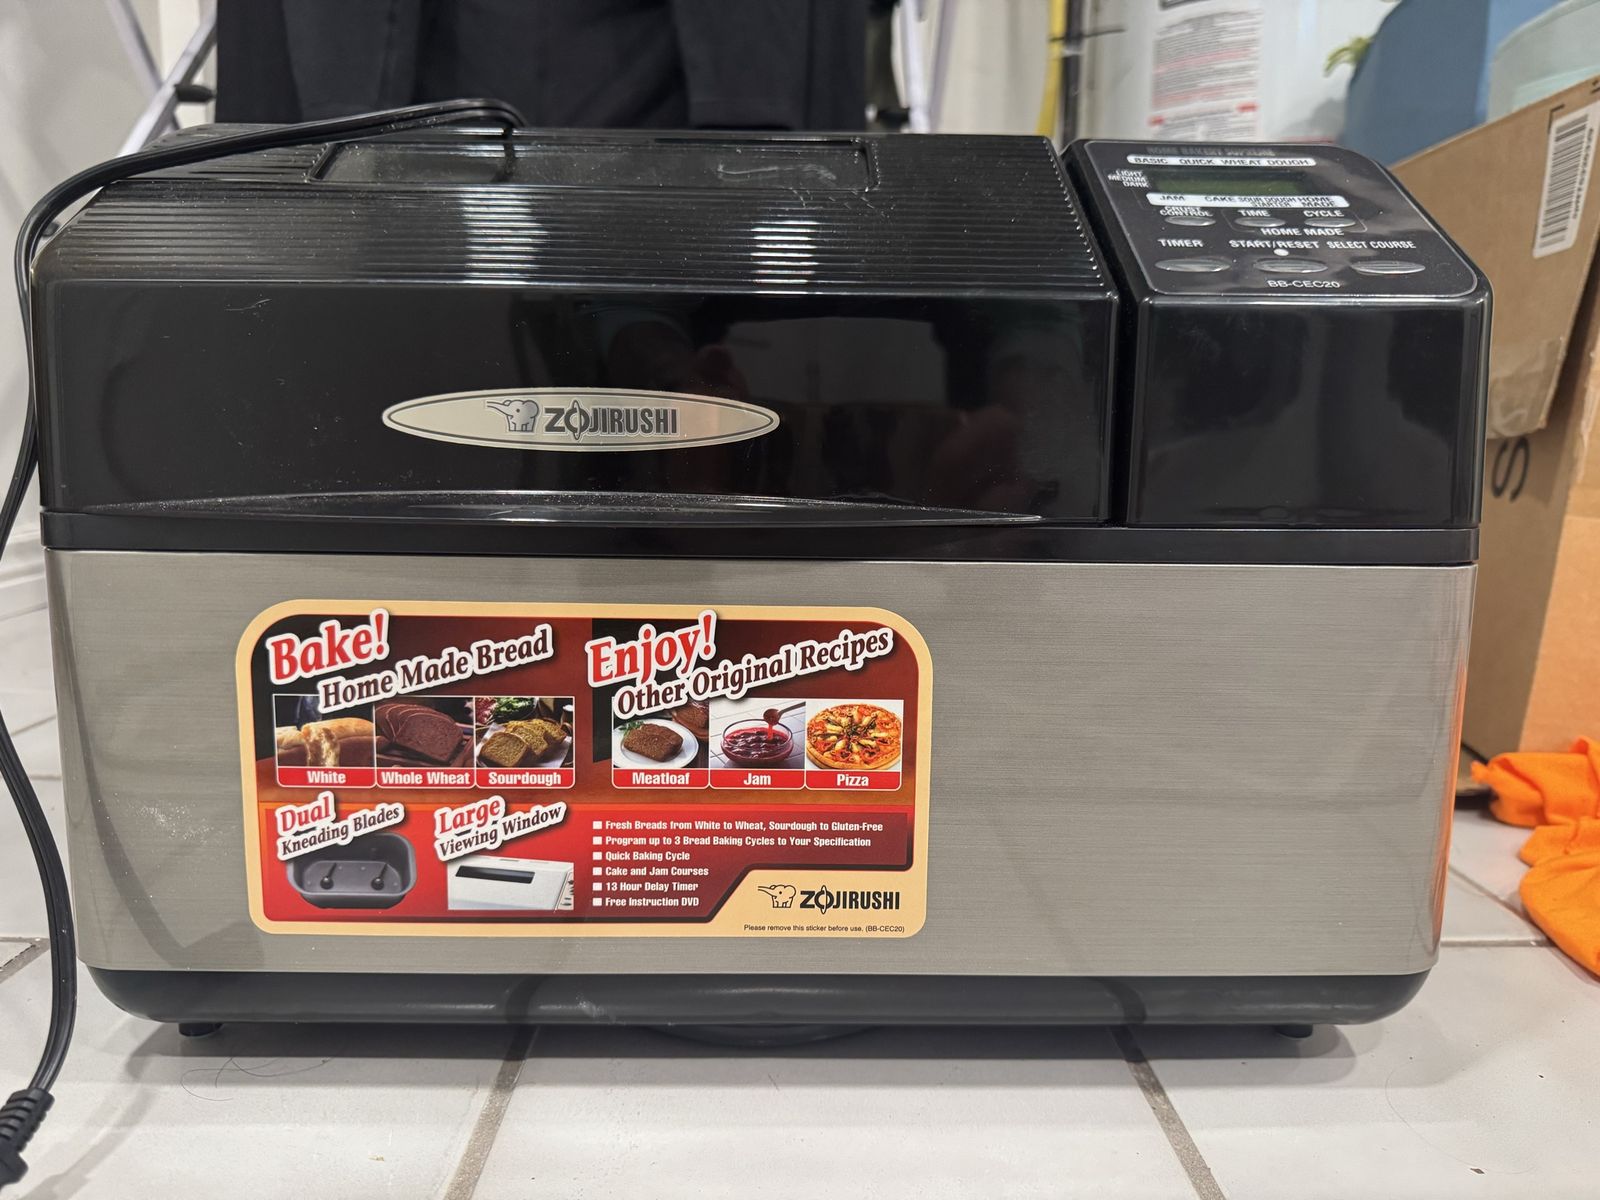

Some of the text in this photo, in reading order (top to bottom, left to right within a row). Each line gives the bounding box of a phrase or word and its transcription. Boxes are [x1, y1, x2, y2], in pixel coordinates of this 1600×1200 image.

[1160, 209, 1213, 217] CONTROL
[1304, 228, 1344, 236] MADE
[1158, 239, 1203, 247] TIMER
[1229, 240, 1319, 249] START/RESET
[1327, 241, 1416, 249] SELECT COURSE
[1267, 280, 1341, 288] BB-CEC20
[545, 400, 678, 441] ZOJIRUSHI
[270, 612, 386, 681] Bake!
[589, 614, 713, 682] Enjoy!
[321, 629, 549, 709] Home Made Bread
[617, 629, 890, 715] Other Original Recipes
[306, 770, 346, 784] White
[381, 771, 470, 785] Whole Wheat
[488, 771, 562, 787] Sourdough
[632, 772, 690, 785] Meatloaf
[743, 773, 772, 786] Jam
[836, 773, 869, 787] Pizza
[279, 796, 331, 832] Dual
[437, 799, 501, 835] Large
[282, 805, 400, 856] Kneading Blades
[439, 805, 562, 858] Viewing Window
[606, 821, 883, 831] Fresh Breads from White to Wheat, Sourdough to Gluten-Free
[606, 836, 871, 847] Program up to 3 Bread Baking Cycles to Your Specification
[606, 851, 690, 861] Quick Baking Cycle
[606, 867, 709, 876] Cake and Jam Courses
[606, 882, 698, 892] 13 Hour Delay Timer
[606, 897, 699, 907] Free Instruction DVD
[800, 885, 899, 914] ZOJIRUSHI
[866, 925, 905, 933] (BB-CEC20)
